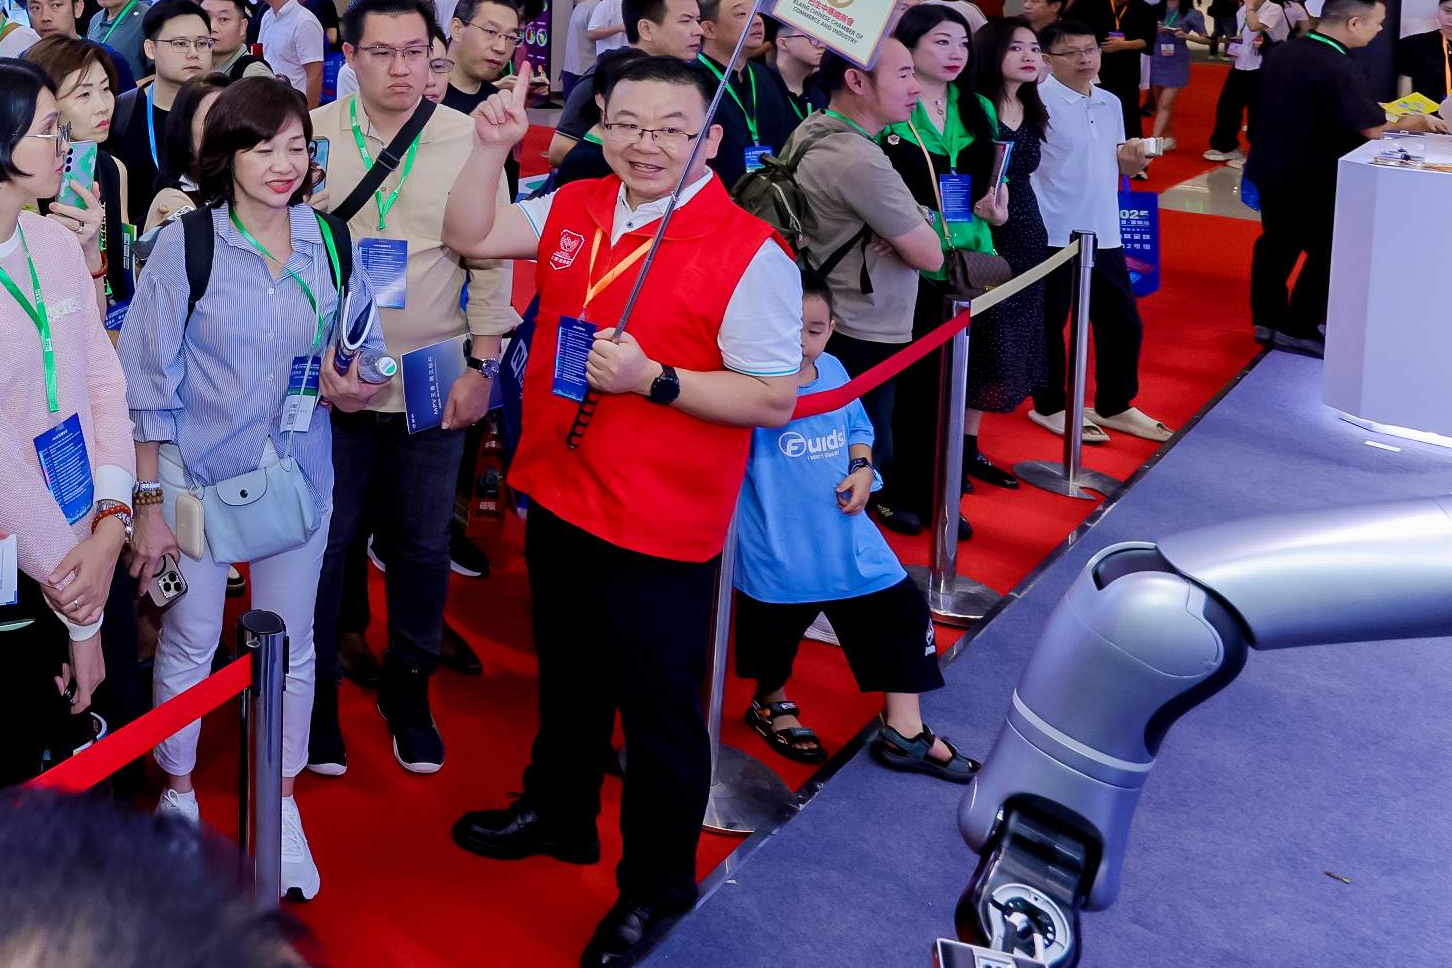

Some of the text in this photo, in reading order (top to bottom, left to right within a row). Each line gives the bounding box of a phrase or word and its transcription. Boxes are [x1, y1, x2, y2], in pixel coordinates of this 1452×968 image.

[792, 6, 858, 45] COMMERCE AND INDUSTRY
[793, 0, 810, 12] KLANG
[810, 6, 831, 23] CHINESE
[831, 18, 856, 35] CHAMBER
